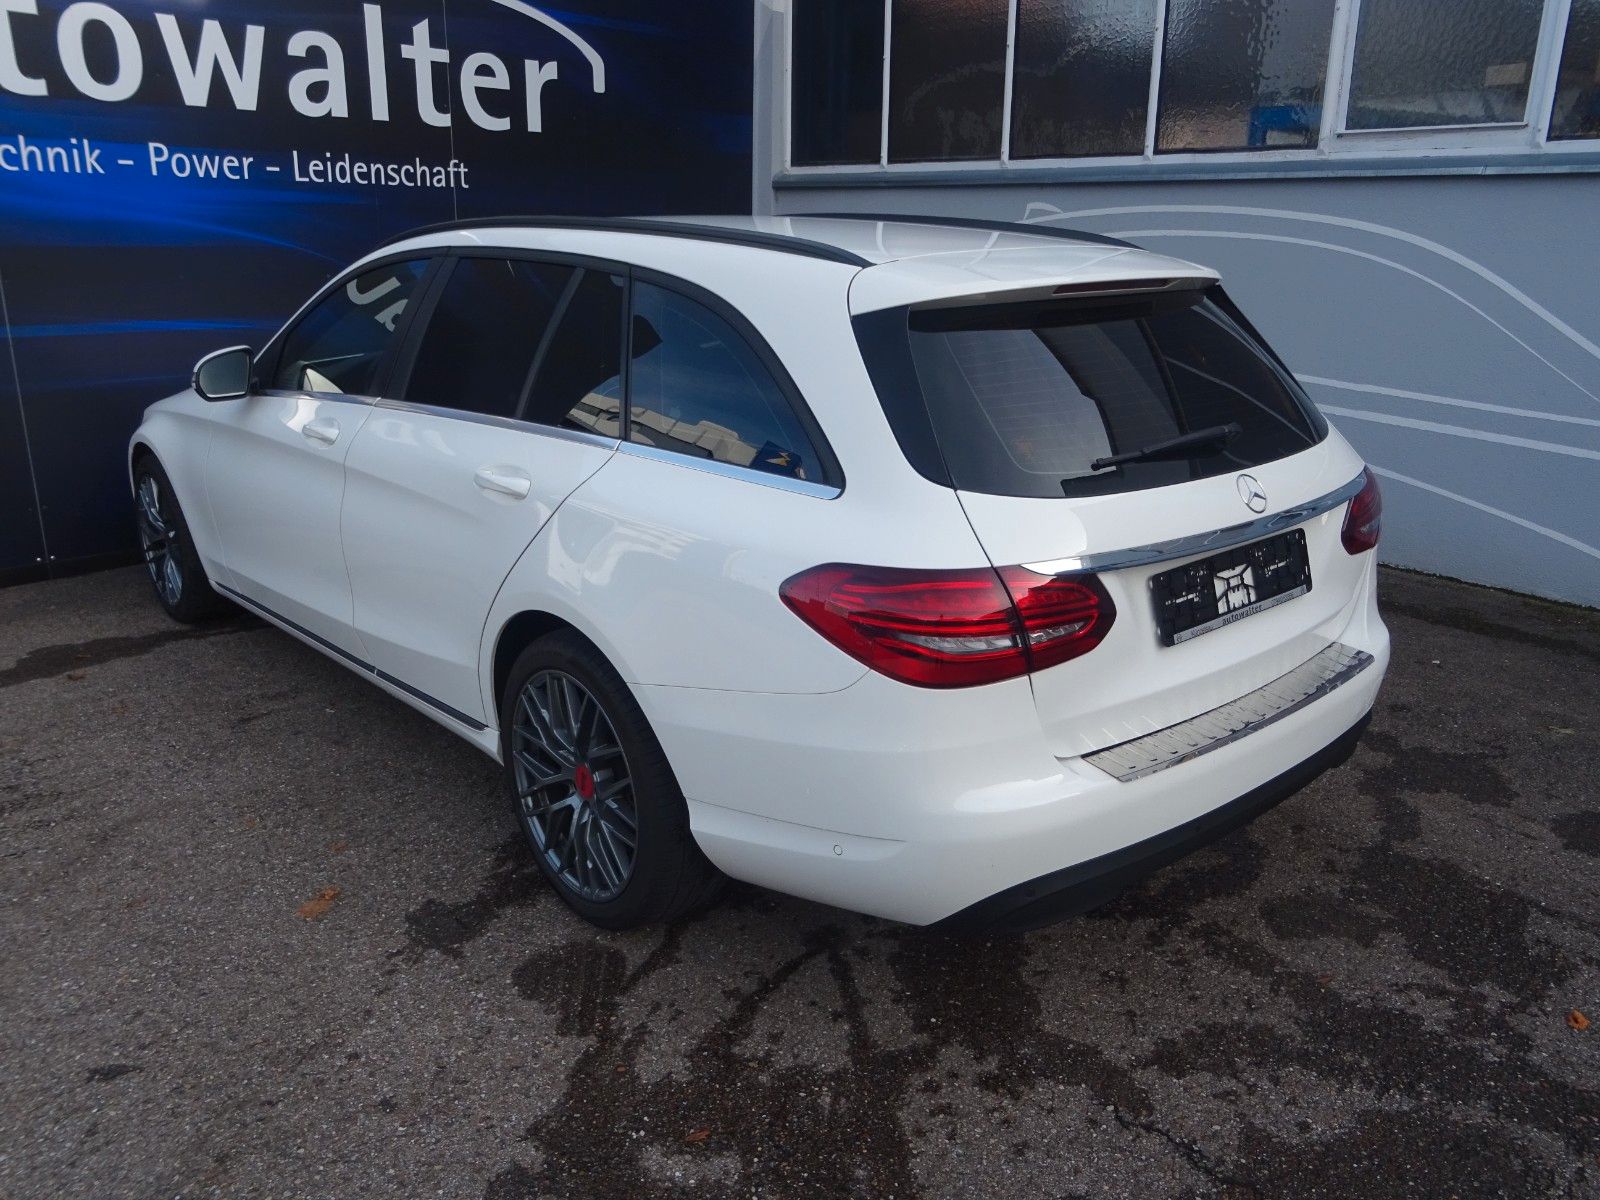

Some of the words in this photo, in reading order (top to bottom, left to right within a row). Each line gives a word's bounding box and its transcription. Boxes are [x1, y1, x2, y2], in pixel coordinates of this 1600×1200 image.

[0, 134, 106, 175] chnik
[149, 142, 254, 180] Power
[293, 150, 469, 189] Leidenschaft
